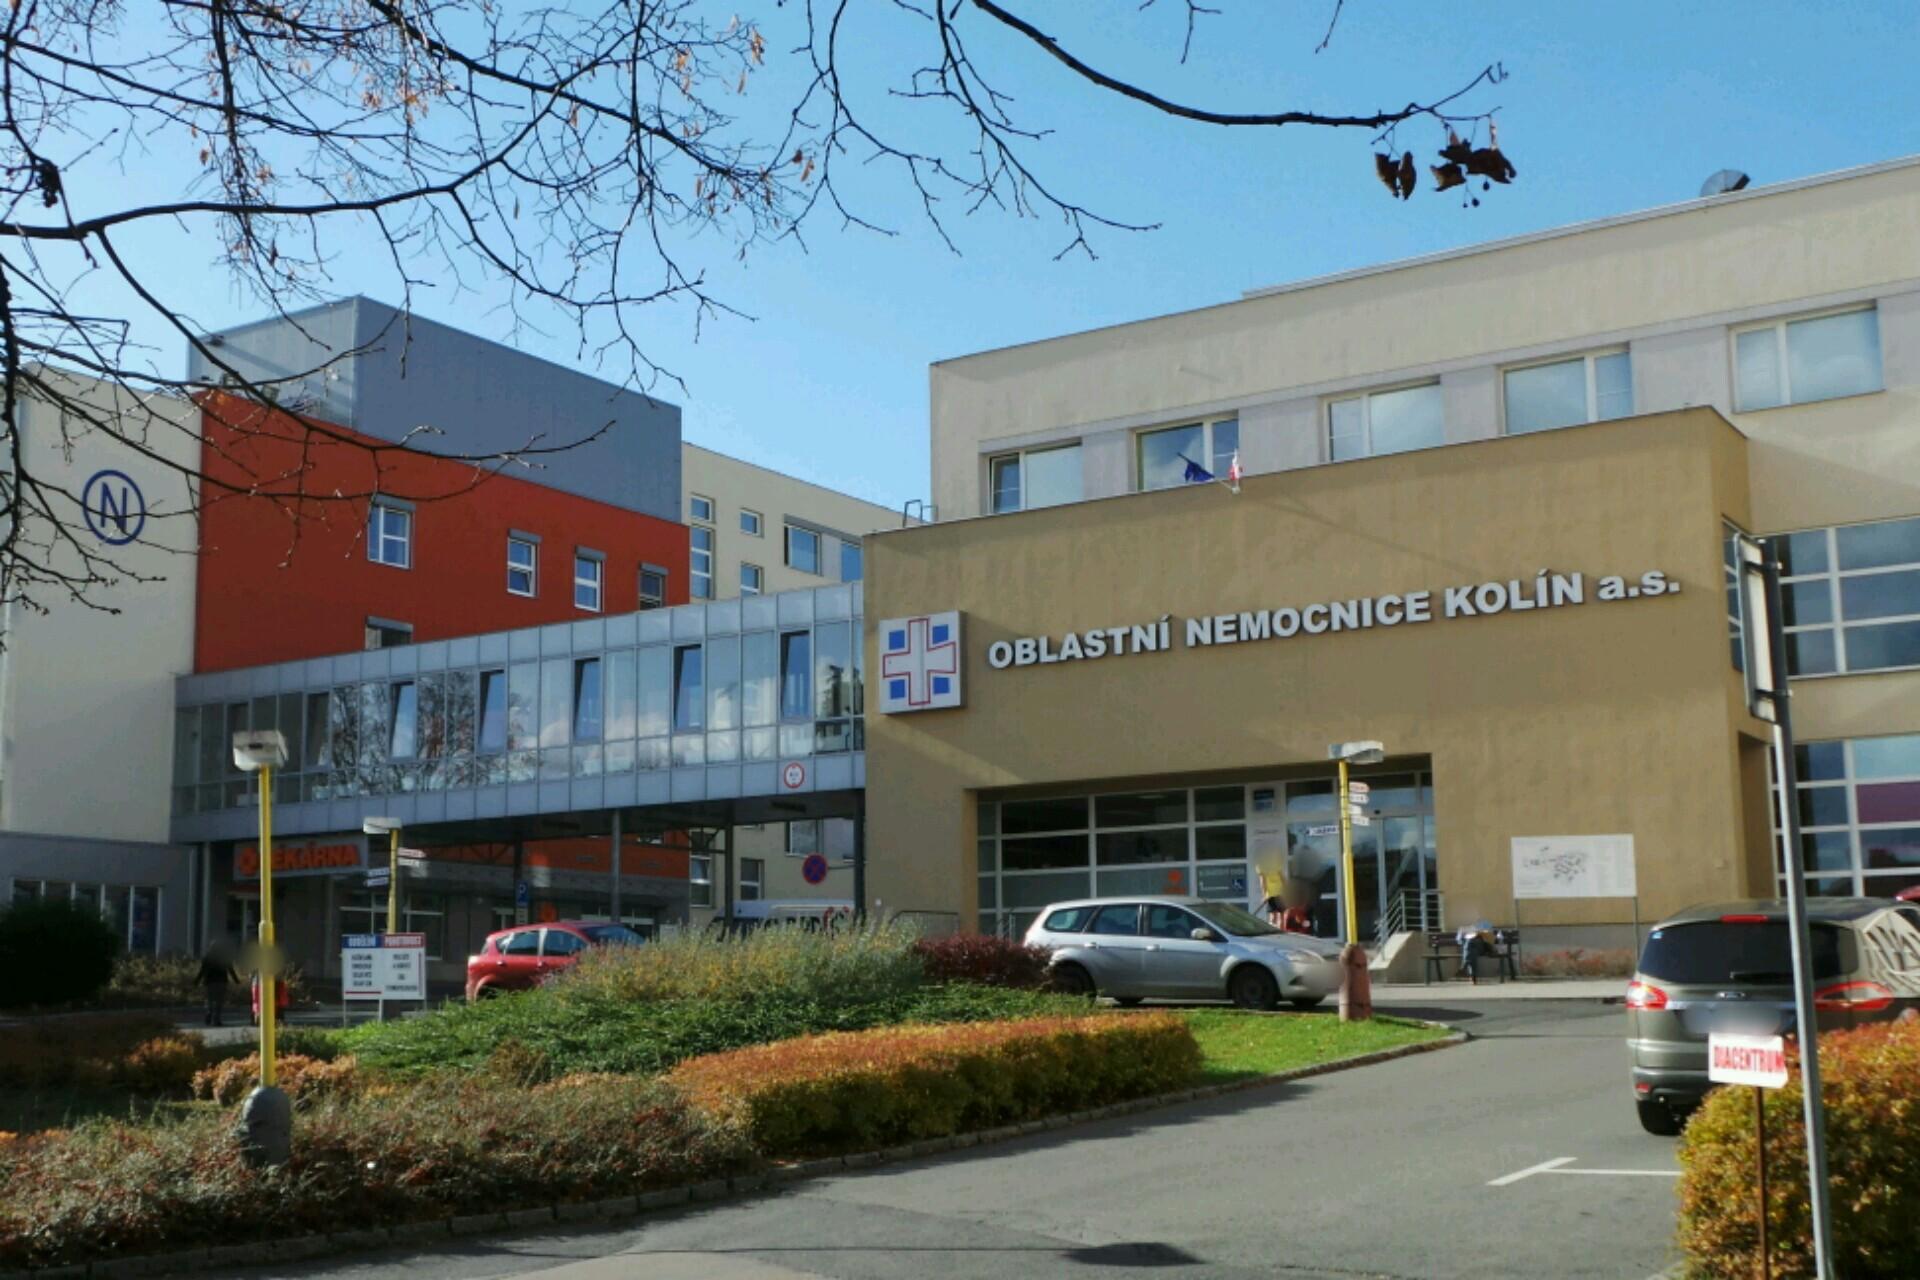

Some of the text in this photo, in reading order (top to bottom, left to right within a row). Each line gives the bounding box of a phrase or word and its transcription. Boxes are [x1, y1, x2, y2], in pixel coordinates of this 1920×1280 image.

[101, 481, 127, 531] N
[988, 568, 1681, 669] OBLASTNÍ NEMOCNICE KOLÍN a.s.
[268, 841, 361, 871] ÉKÁRNA
[1713, 1045, 1785, 1073] DIACENTRUM
